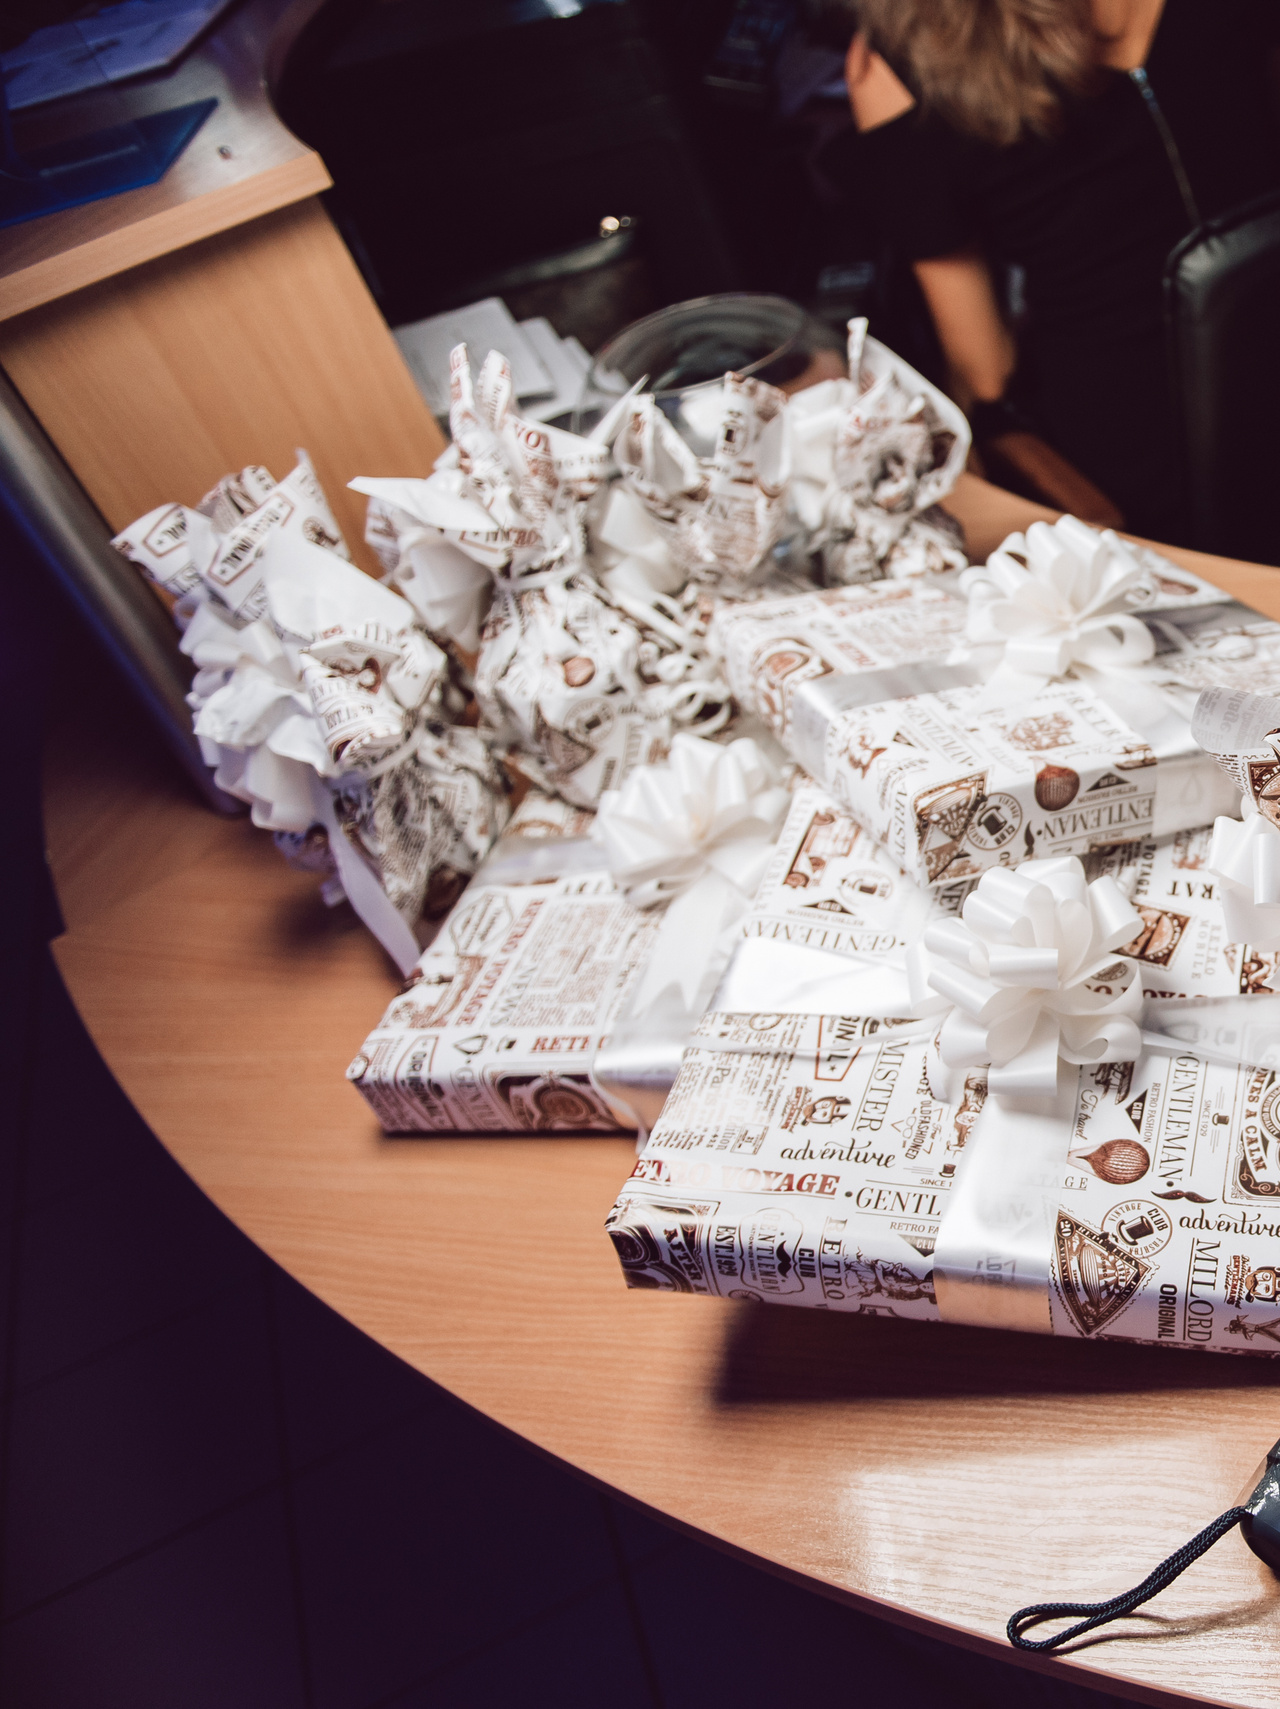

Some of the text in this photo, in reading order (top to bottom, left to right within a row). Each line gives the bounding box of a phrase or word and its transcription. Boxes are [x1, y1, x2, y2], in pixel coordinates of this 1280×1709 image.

[1044, 798, 1153, 841] ENTLEMAN
[1143, 1108, 1157, 1143] FASHION
[1158, 1055, 1200, 1181] GENTLEMAN
[780, 1139, 896, 1168] adventure
[1245, 1125, 1267, 1172] CALM
[721, 1165, 841, 1196] VOYAGE
[919, 1178, 946, 1187] SINCE
[890, 1221, 926, 1233] RETRO
[1107, 1202, 1142, 1222] VINTAGE
[1147, 1208, 1169, 1231] CLUB
[822, 1217, 849, 1300] RETRO
[1187, 1238, 1221, 1343] MILORD
[1157, 1283, 1178, 1339] ORIGINAL
